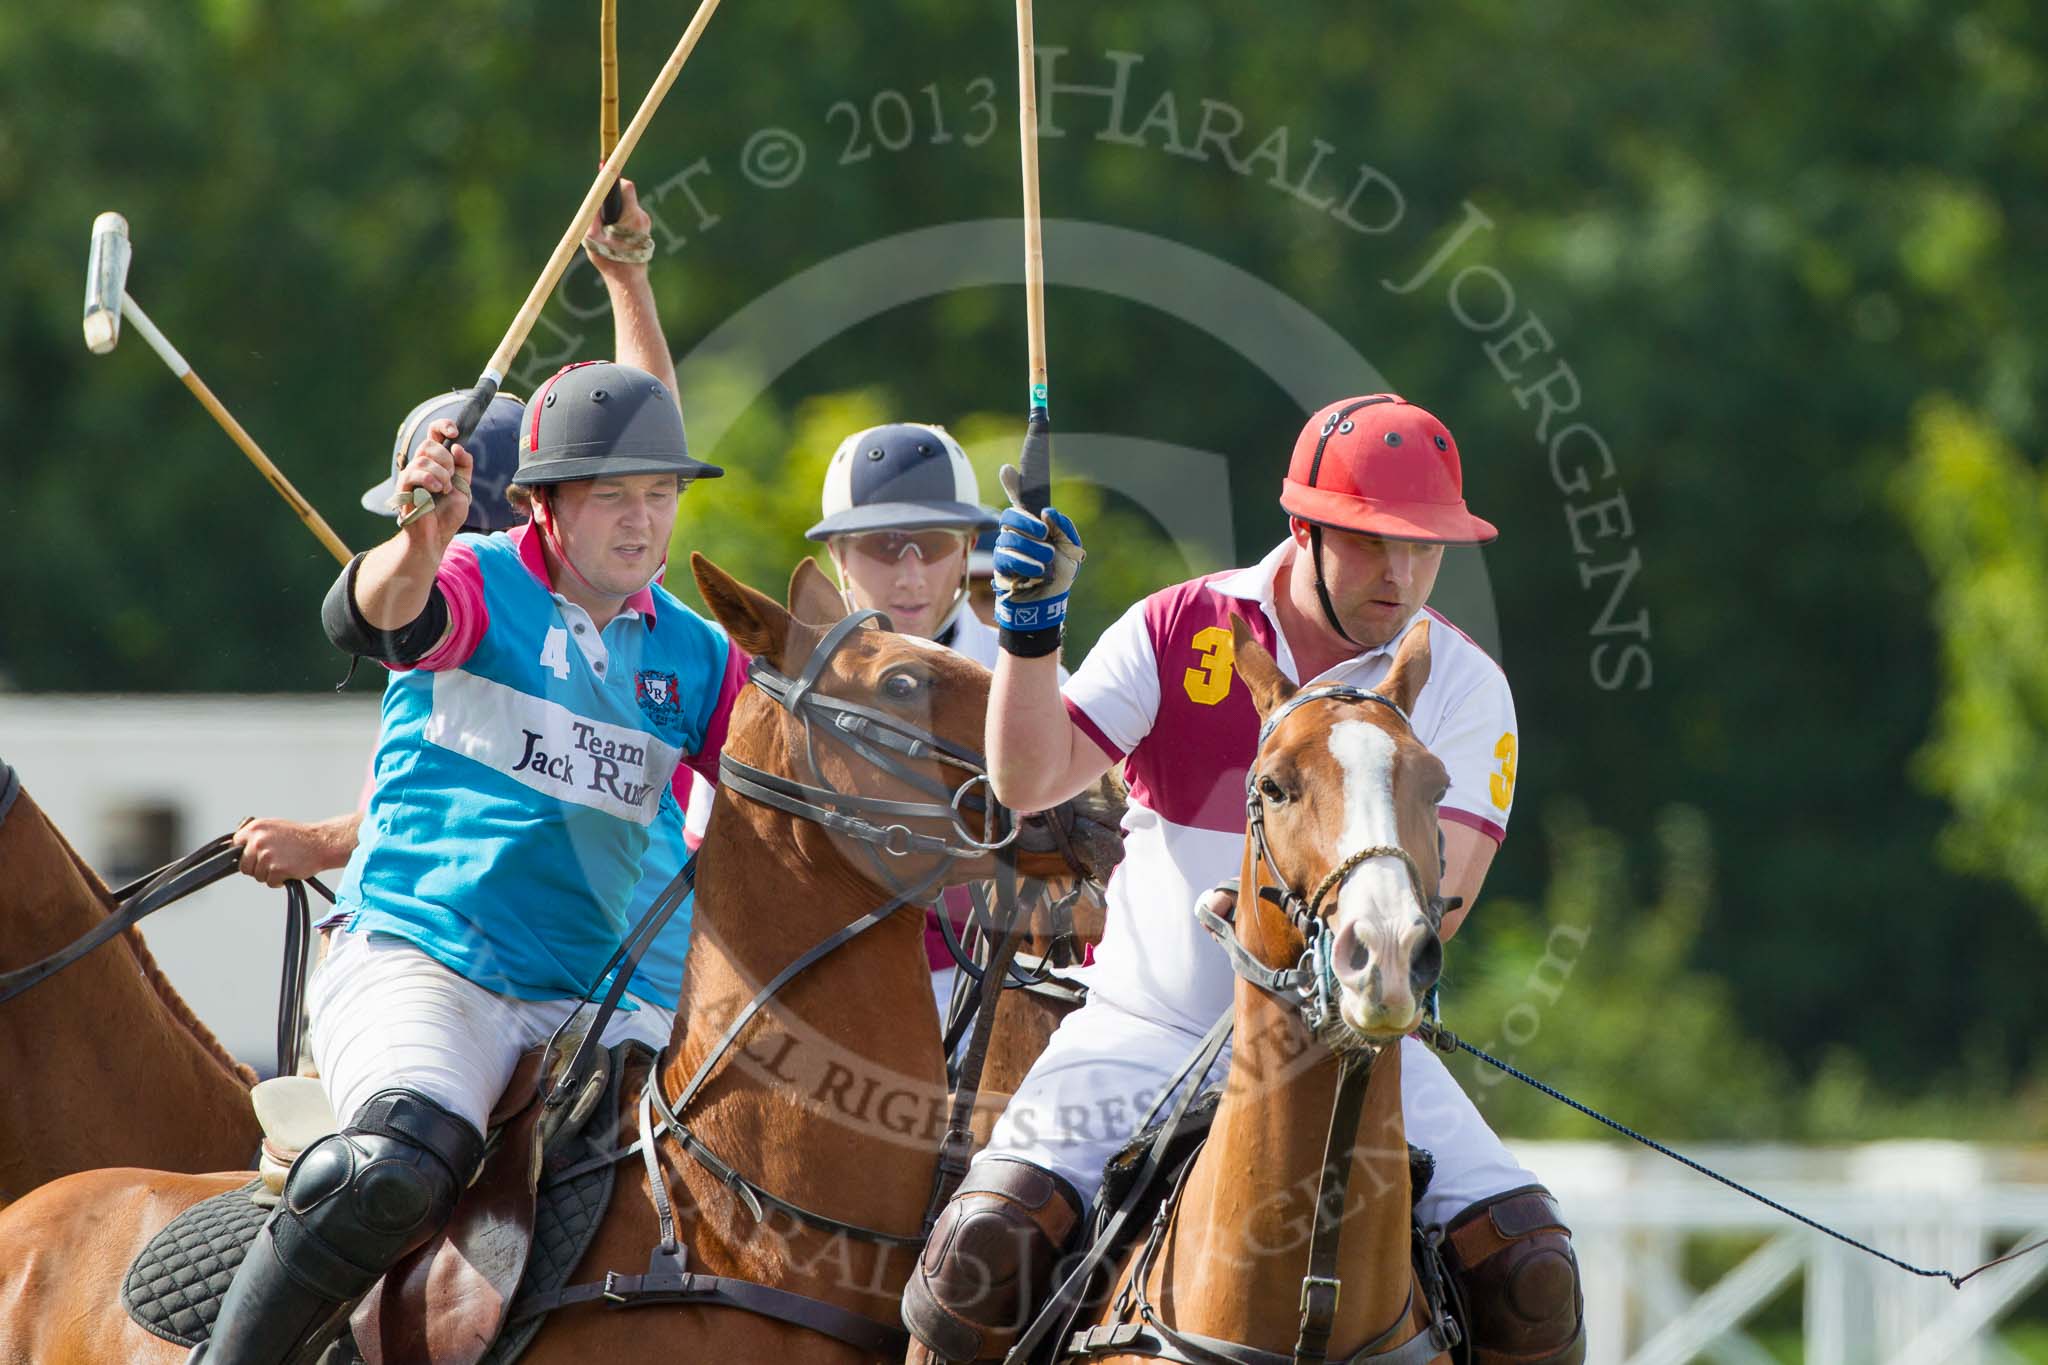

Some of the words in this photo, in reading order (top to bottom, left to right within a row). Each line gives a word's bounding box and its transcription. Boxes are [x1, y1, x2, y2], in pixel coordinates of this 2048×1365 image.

[540, 625, 571, 681] 4
[1184, 626, 1235, 705] 3
[513, 729, 576, 787] Jack
[572, 721, 645, 767] Team
[1488, 731, 1517, 812] 3
